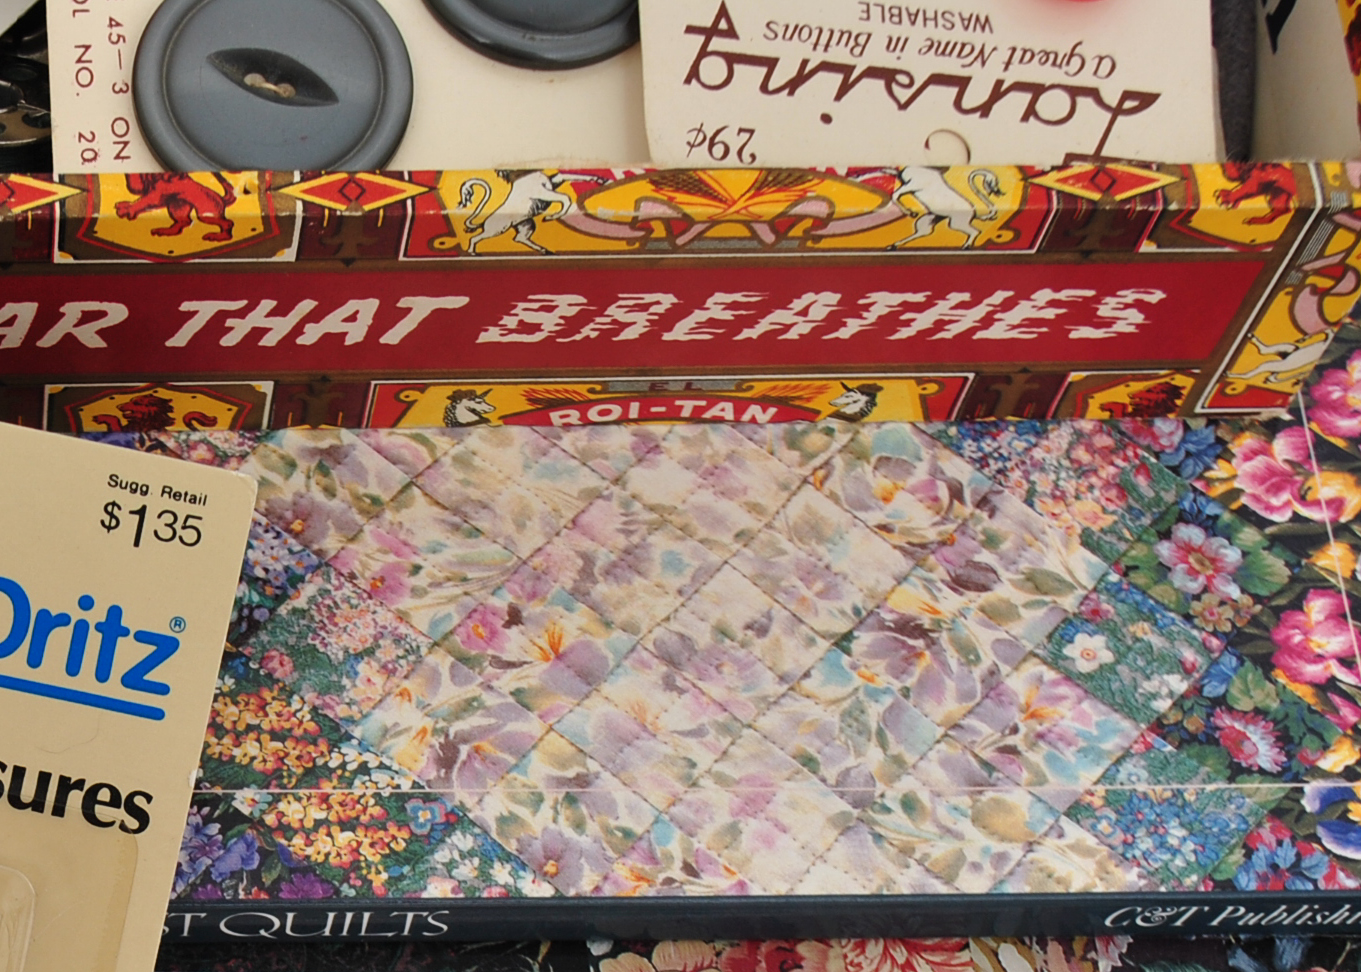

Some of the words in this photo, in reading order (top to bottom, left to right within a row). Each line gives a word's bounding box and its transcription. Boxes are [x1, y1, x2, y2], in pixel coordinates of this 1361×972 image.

[858, 1, 993, 34] WASHABLE
[762, 19, 872, 58] Buttons
[885, 33, 910, 60] in
[918, 37, 998, 68] Name
[74, 44, 94, 97] NO.
[1003, 40, 1086, 78] Great
[1096, 54, 1117, 79] a
[683, 0, 1162, 166] Lansing
[111, 116, 131, 160] ON
[165, 296, 470, 346] THAT
[475, 288, 1168, 342] BREATHES
[549, 400, 778, 426] ROI-TAN
[107, 473, 154, 497] Sugg.
[160, 484, 208, 507] Retail
[218, 910, 450, 940] QUILTS
[1103, 905, 1209, 928] C&T
